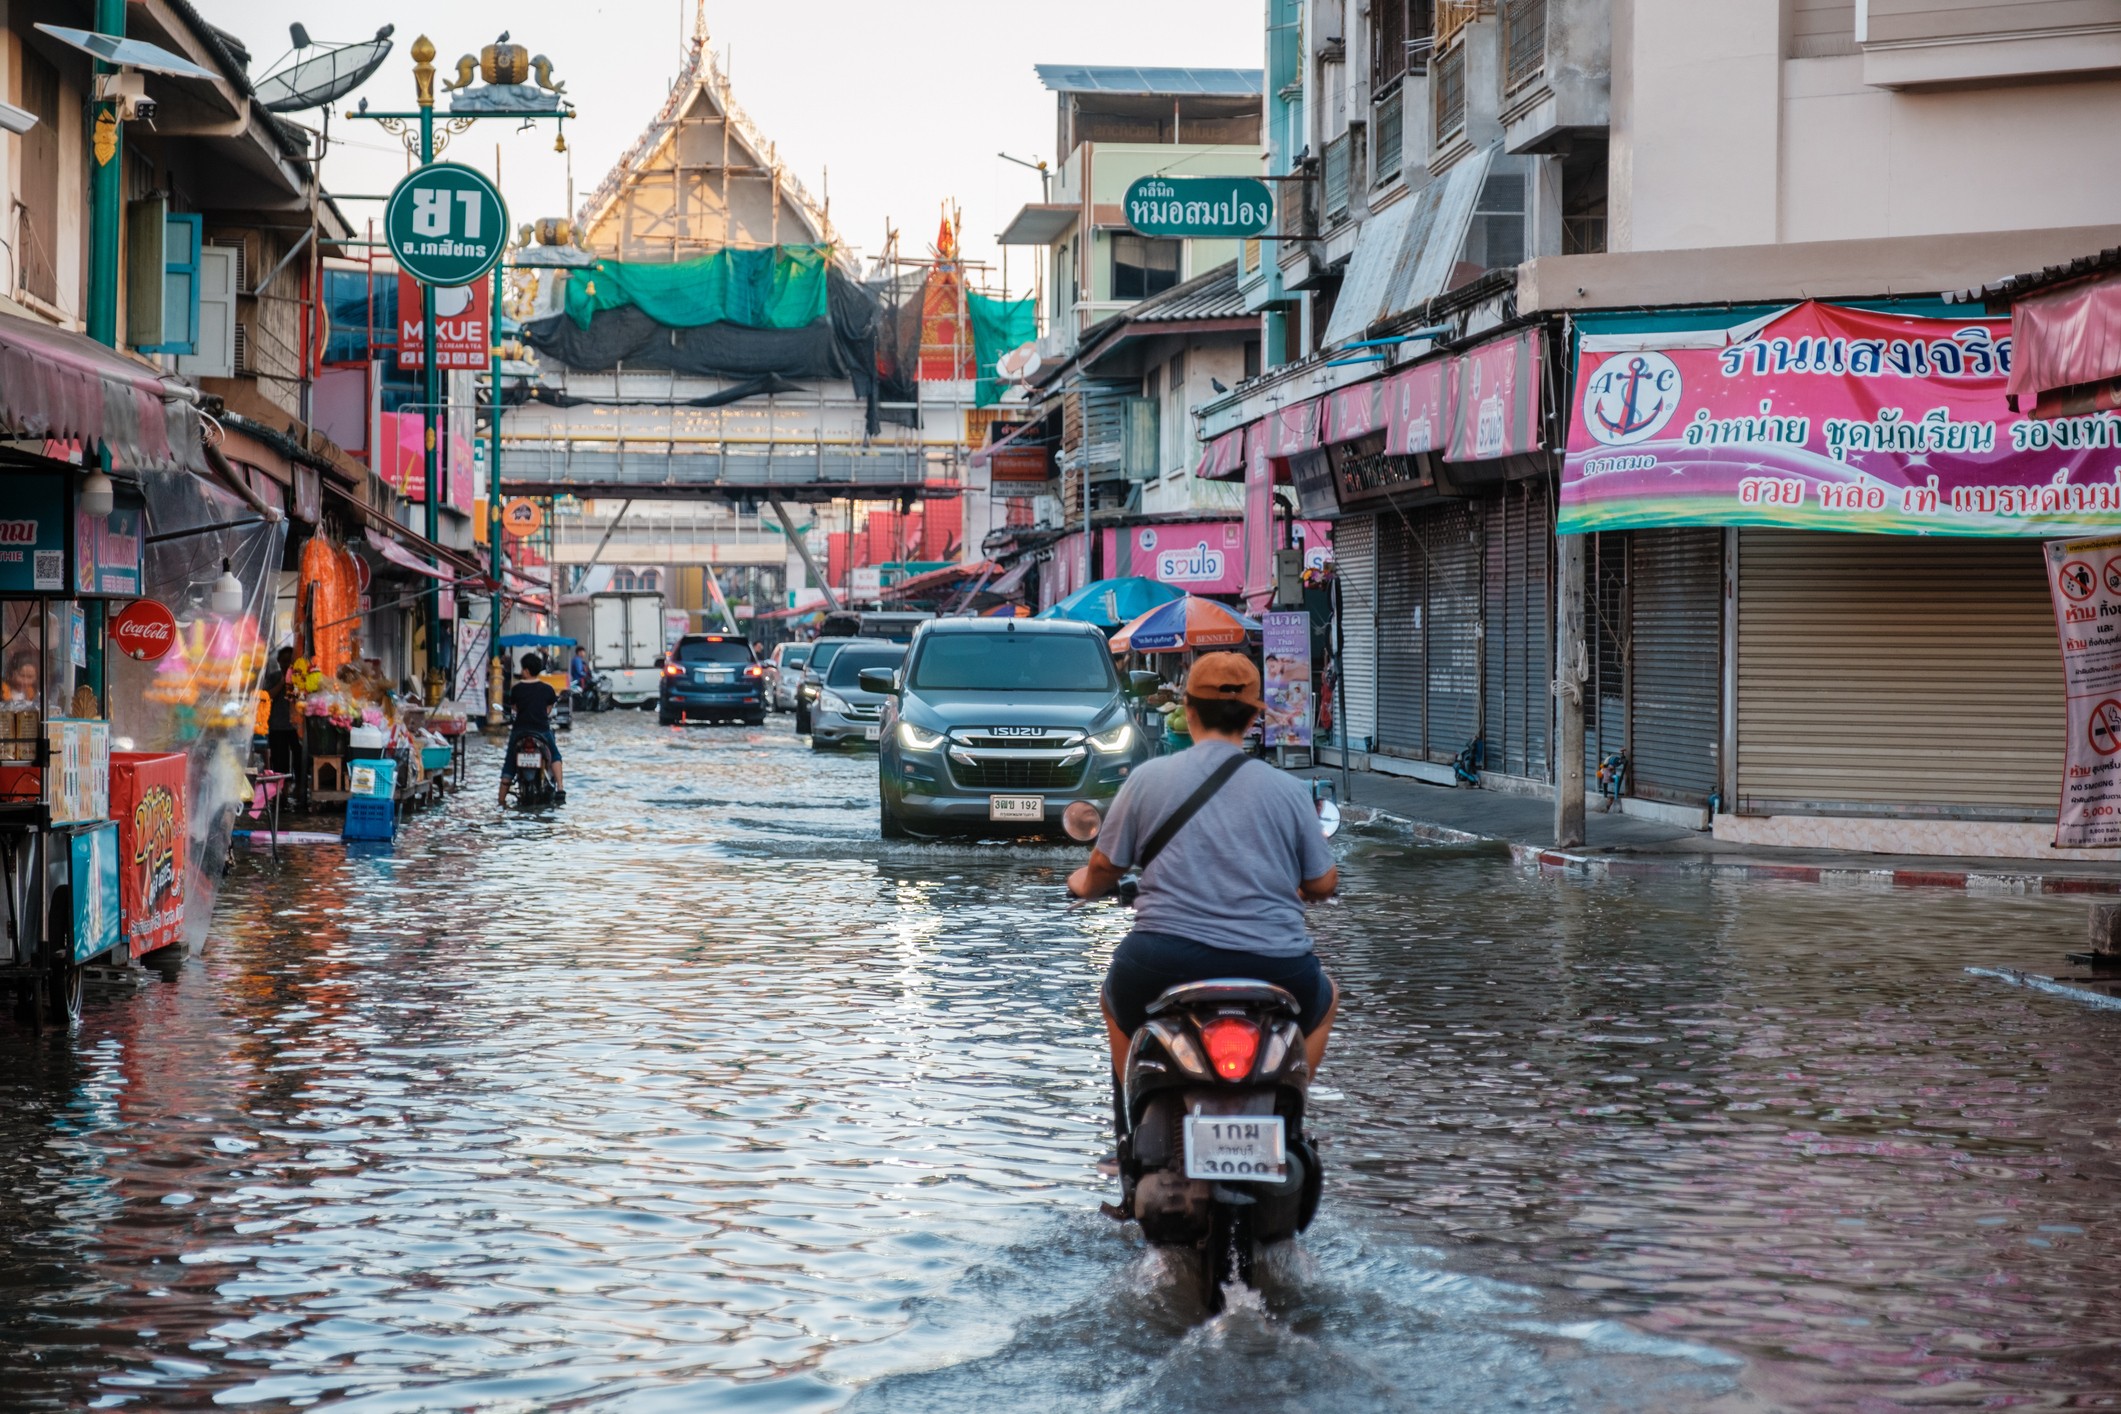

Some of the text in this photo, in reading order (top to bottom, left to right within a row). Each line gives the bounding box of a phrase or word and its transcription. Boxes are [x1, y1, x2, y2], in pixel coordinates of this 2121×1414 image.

[412, 188, 482, 238] ยา
[1130, 188, 1268, 226] หมอสมปอง
[403, 320, 482, 341] MXUE
[1590, 372, 1614, 393] A
[1686, 402, 1807, 445] จำหน่าย
[1826, 409, 1993, 461] ชุดนักเรียน
[1585, 455, 1655, 475] ตราสมอ
[1741, 471, 2121, 513] สวย หล่อ เท่ แบรนด์เนม
[2065, 604, 2097, 620] ห้าม
[1269, 614, 1301, 626] นวด
[119, 619, 171, 639] Coca-Cola
[2096, 624, 2114, 633] และ
[1196, 632, 1235, 643] BENNETT
[2066, 638, 2088, 650] ห้าม
[993, 727, 1042, 736] ISUZU
[2070, 765, 2092, 776] ห้าม
[2070, 779, 2114, 792] NO SMOKING
[1020, 800, 1037, 810] 192
[2083, 806, 2114, 819] 5,000
